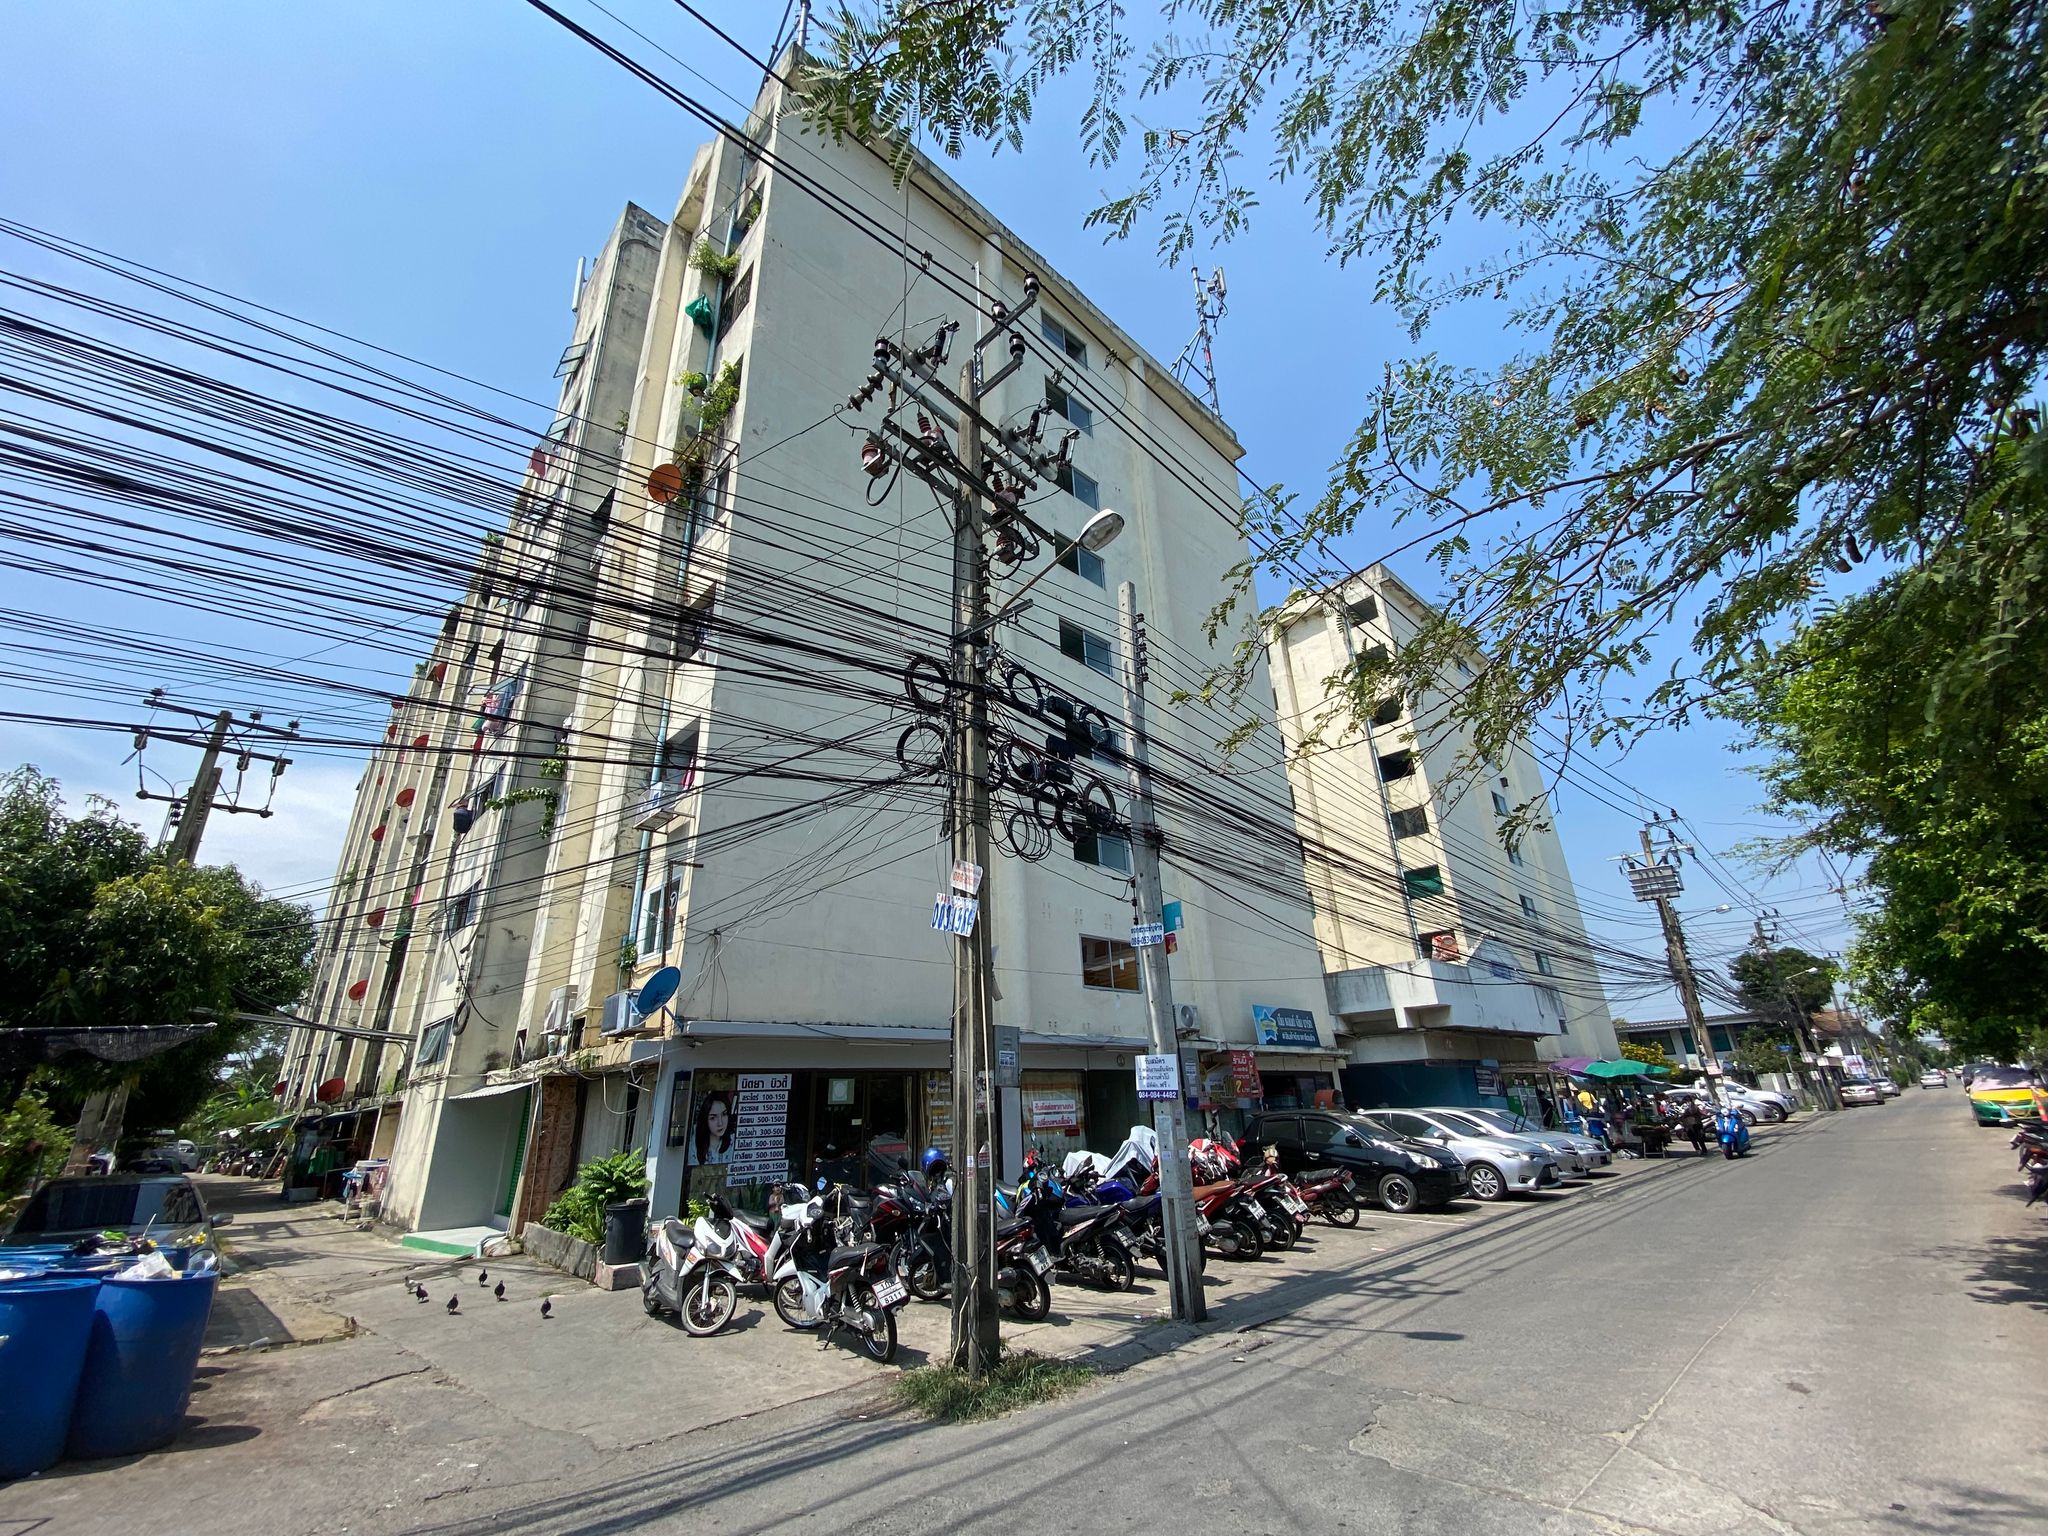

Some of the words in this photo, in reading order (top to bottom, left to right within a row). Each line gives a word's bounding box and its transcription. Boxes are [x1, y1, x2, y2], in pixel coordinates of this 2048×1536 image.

[757, 1115, 785, 1123] 500-1500
[759, 1128, 784, 1136] 300-500
[755, 1140, 784, 1148] 500-1000
[755, 1150, 784, 1159] 500-1000
[885, 1292, 902, 1303] 8311
